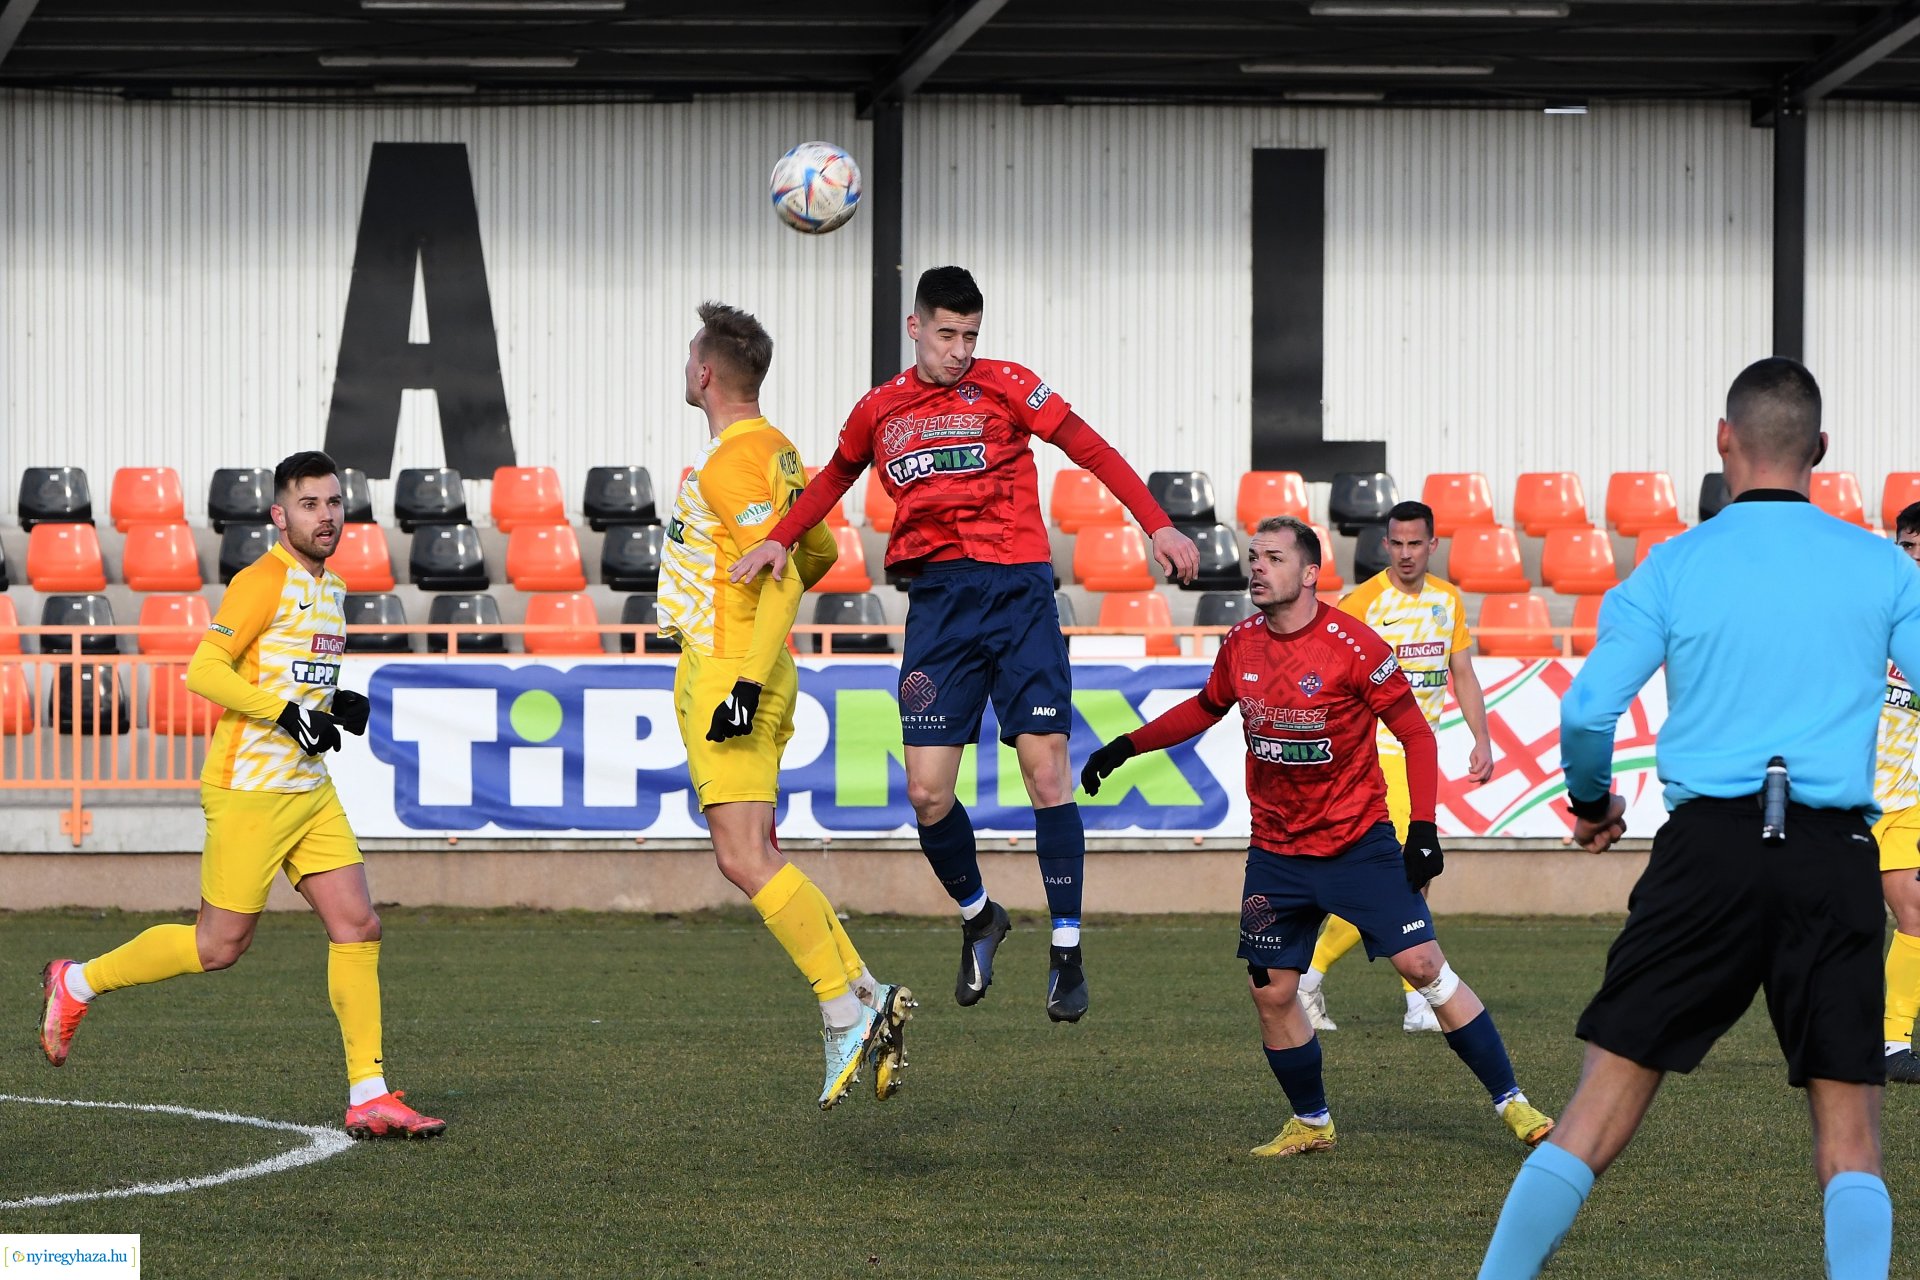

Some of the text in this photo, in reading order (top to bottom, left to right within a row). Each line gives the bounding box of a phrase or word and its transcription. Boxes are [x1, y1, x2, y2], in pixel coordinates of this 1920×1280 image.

[323, 142, 517, 480] A
[1252, 148, 1387, 482] L
[1032, 706, 1057, 717] JAKO
[1045, 875, 1072, 885] JAKO
[1402, 919, 1426, 934] JAKO
